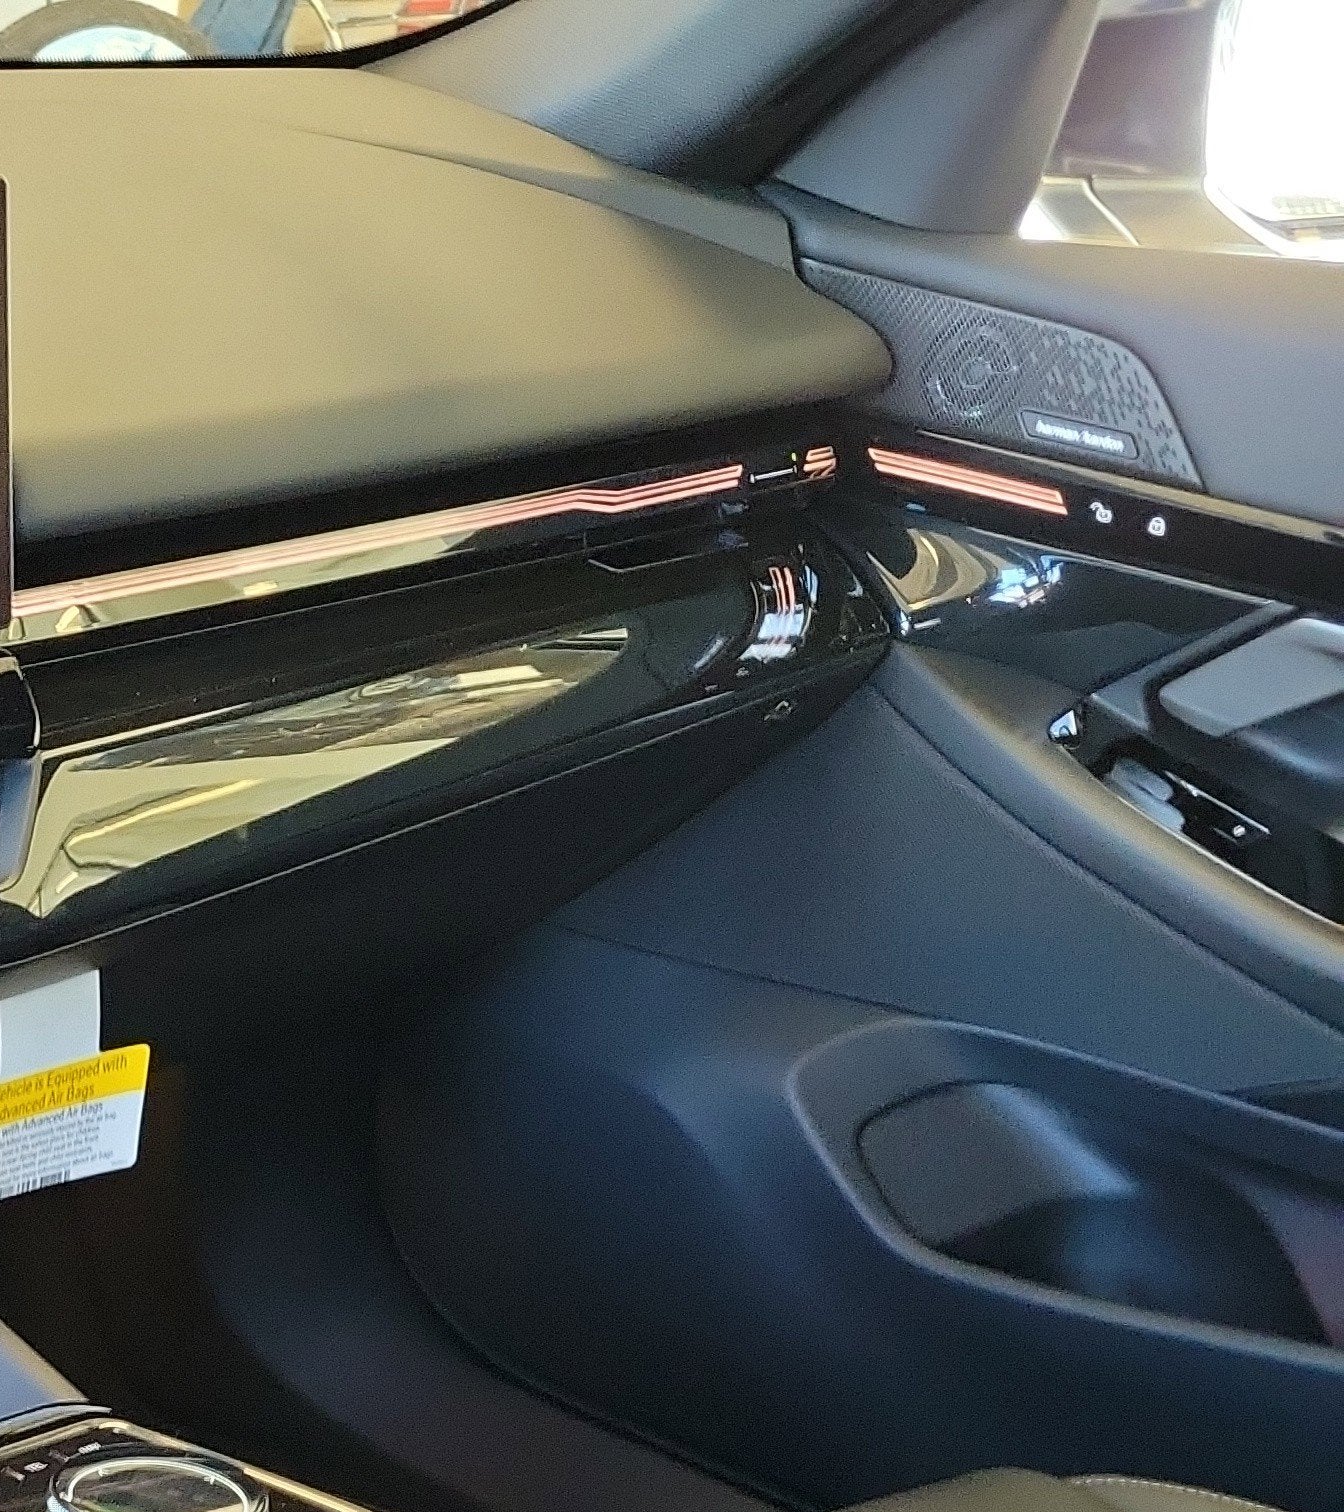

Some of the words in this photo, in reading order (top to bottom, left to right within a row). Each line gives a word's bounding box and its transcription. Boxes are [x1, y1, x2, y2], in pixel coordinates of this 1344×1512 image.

[35, 1076, 45, 1088] is
[47, 1062, 100, 1087] Equipped
[102, 1055, 128, 1072] with
[50, 1091, 62, 1104] Air
[66, 1085, 95, 1102] Bags
[1, 1122, 20, 1137] with
[22, 1111, 65, 1131] Advanced
[67, 1106, 79, 1118] Air
[81, 1102, 104, 1116] Bags
